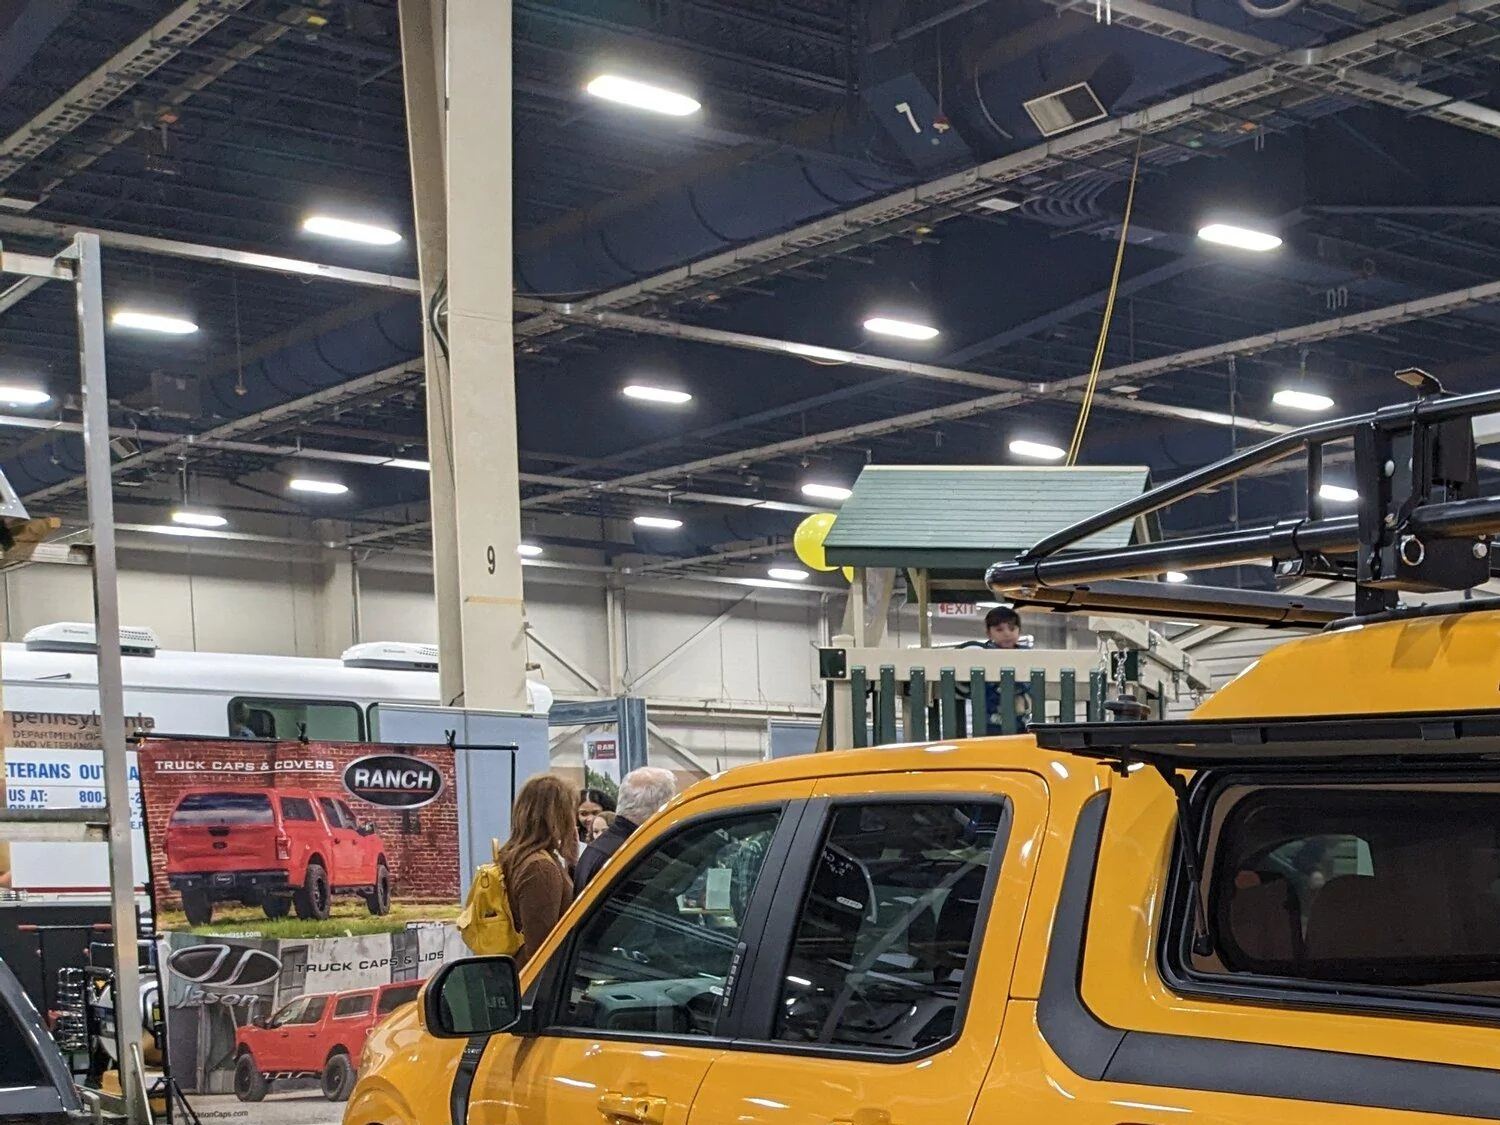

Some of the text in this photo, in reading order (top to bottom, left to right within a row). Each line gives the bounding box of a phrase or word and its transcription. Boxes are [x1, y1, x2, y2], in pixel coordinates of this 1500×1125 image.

[487, 545, 495, 575] 9
[946, 603, 975, 615] EXIT
[11, 709, 155, 729] pennsylnia
[13, 730, 77, 741] DEPARTMENT
[597, 743, 615, 751] RAM
[155, 759, 334, 771] TRUCK CAPS & COVERS
[355, 768, 433, 789] RANCH
[9, 789, 25, 802] US
[30, 789, 48, 802] AT:
[296, 951, 444, 973] TRUCK CAPS & LIDS
[176, 985, 259, 1009] Jason
